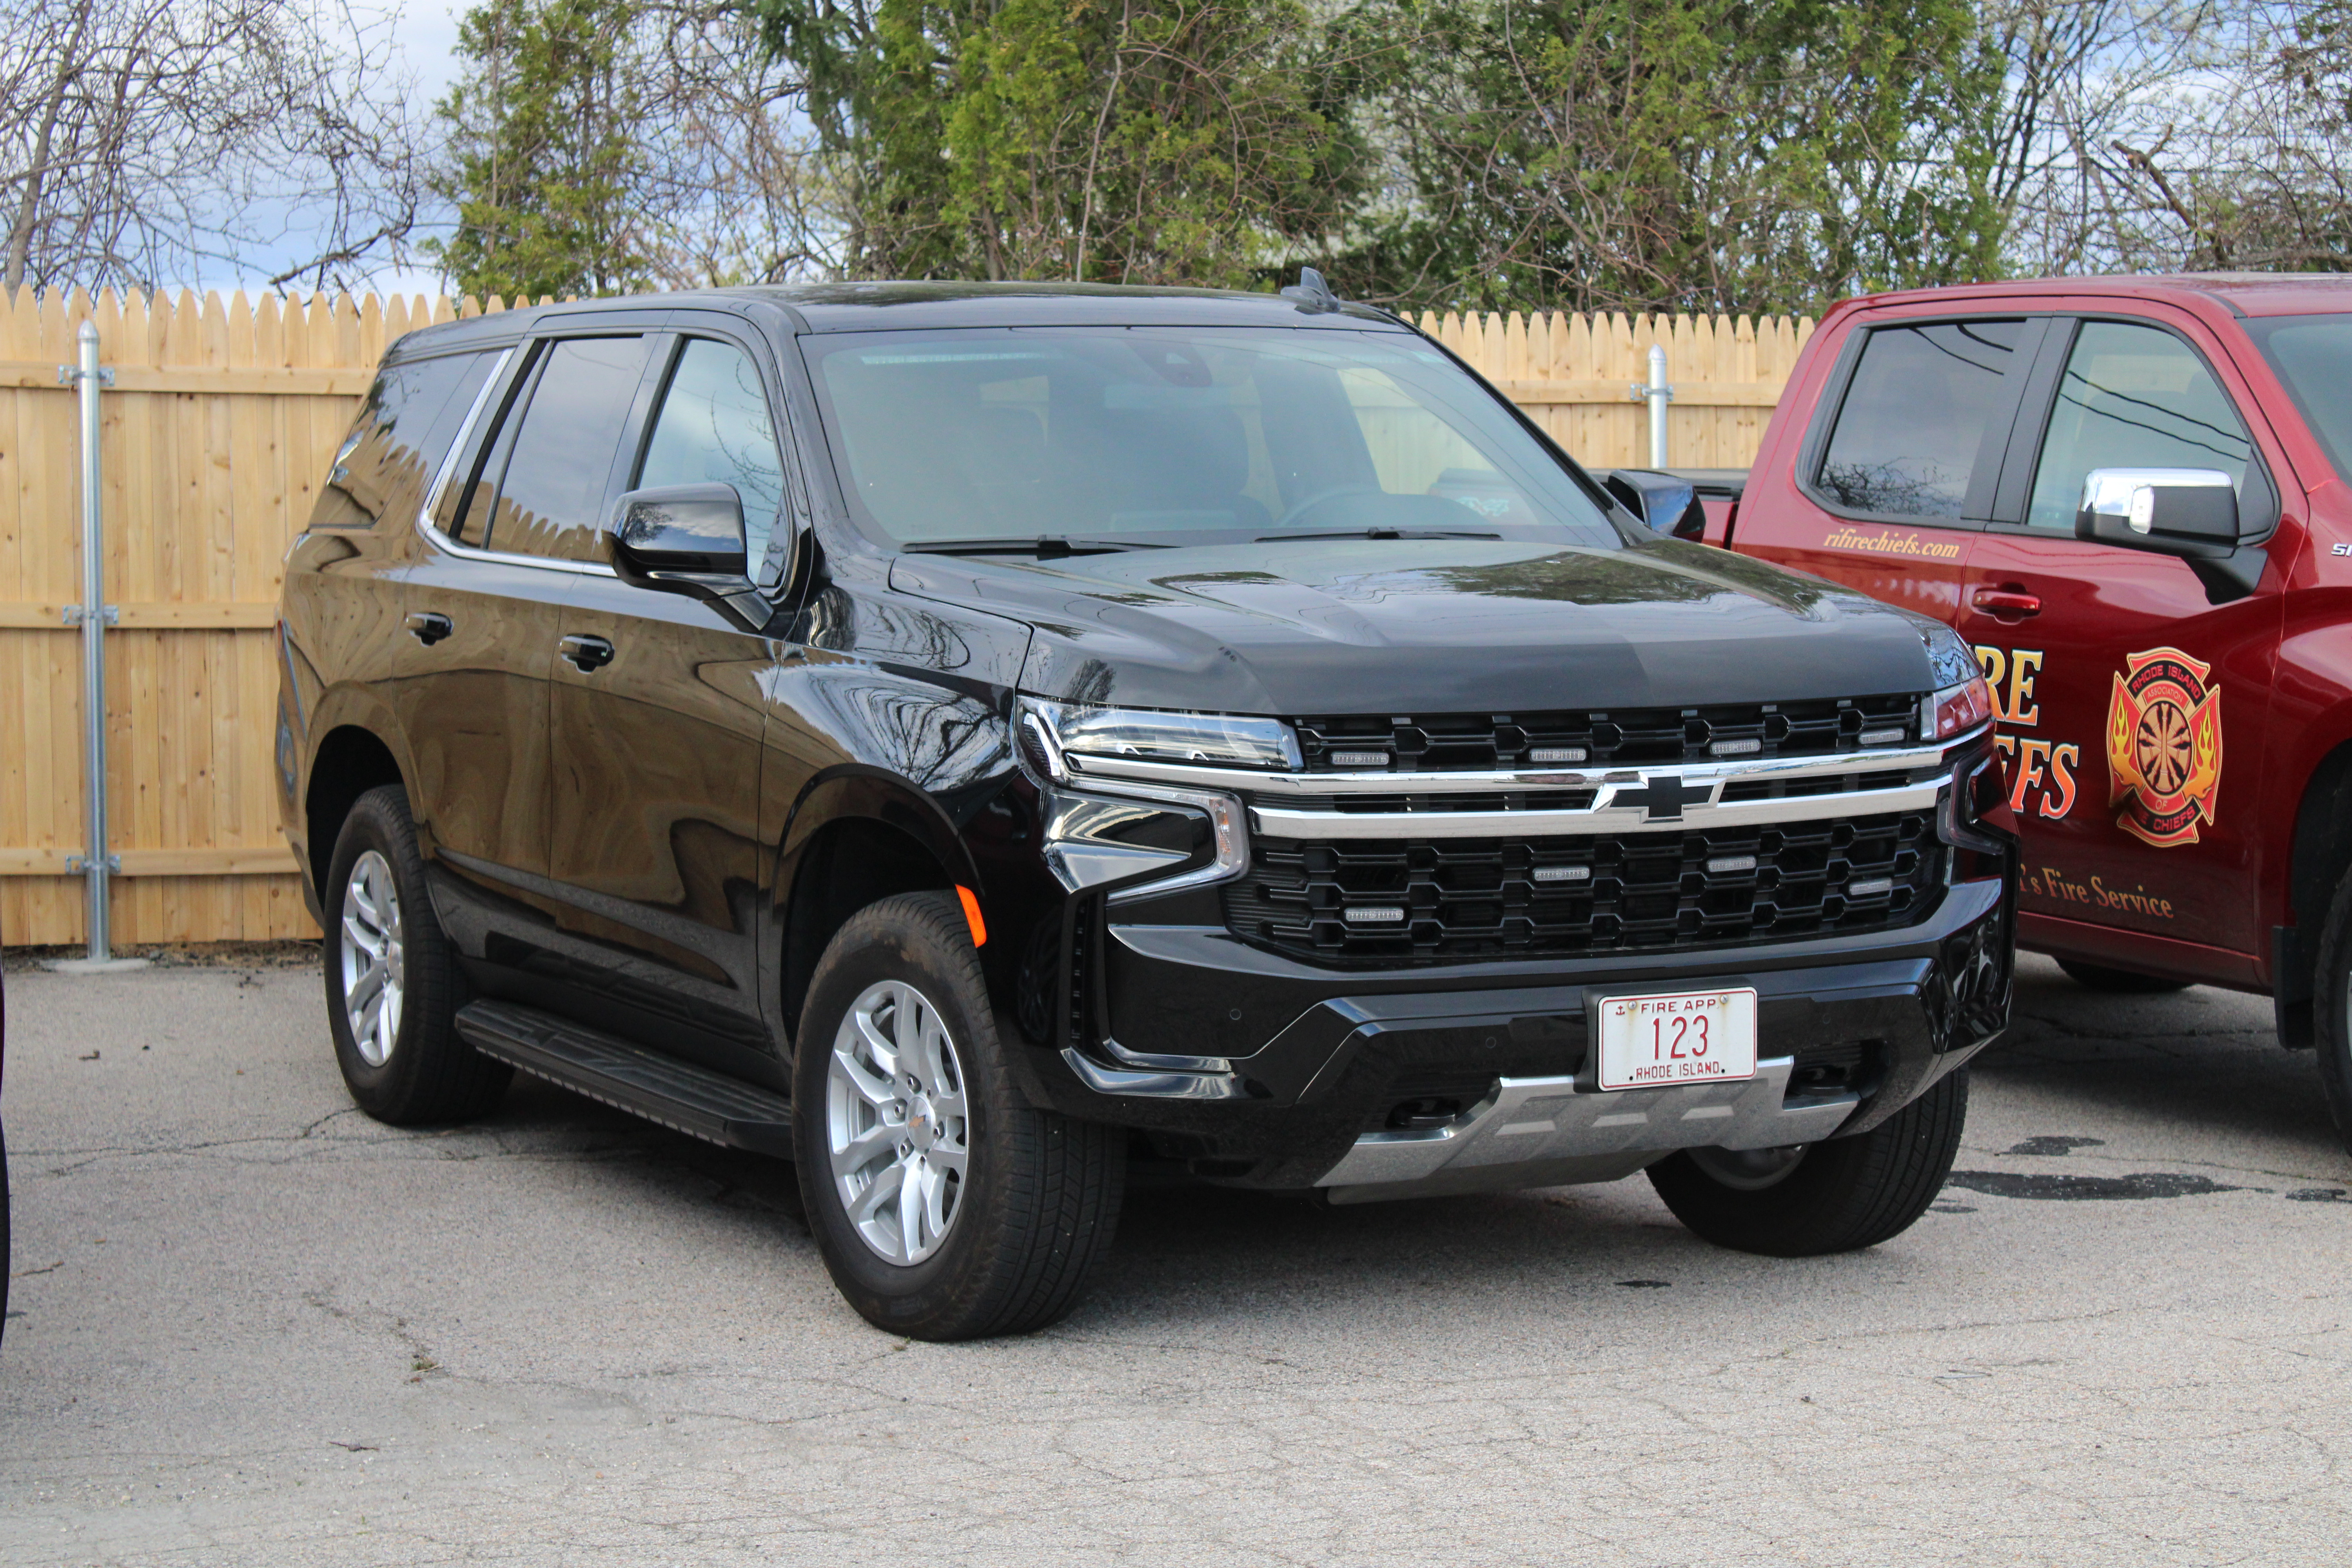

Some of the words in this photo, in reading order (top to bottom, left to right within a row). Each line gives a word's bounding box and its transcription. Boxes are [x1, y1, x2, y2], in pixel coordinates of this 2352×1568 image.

[1824, 528, 1960, 558] rifirechiefs.com
[2131, 665, 2164, 692] RHODE
[2168, 665, 2201, 699] ISLAND
[2147, 686, 2183, 703] ASSOCIATION
[2155, 799, 2168, 811] OF
[2153, 806, 2196, 831] CHIEFS
[2042, 867, 2089, 903] Fire
[2091, 876, 2174, 918] Service
[1641, 1001, 1677, 1014] FIRE
[1653, 1015, 1708, 1060] 123
[1635, 1064, 1672, 1080] RHODE
[1679, 1061, 1720, 1076] ISLAND
